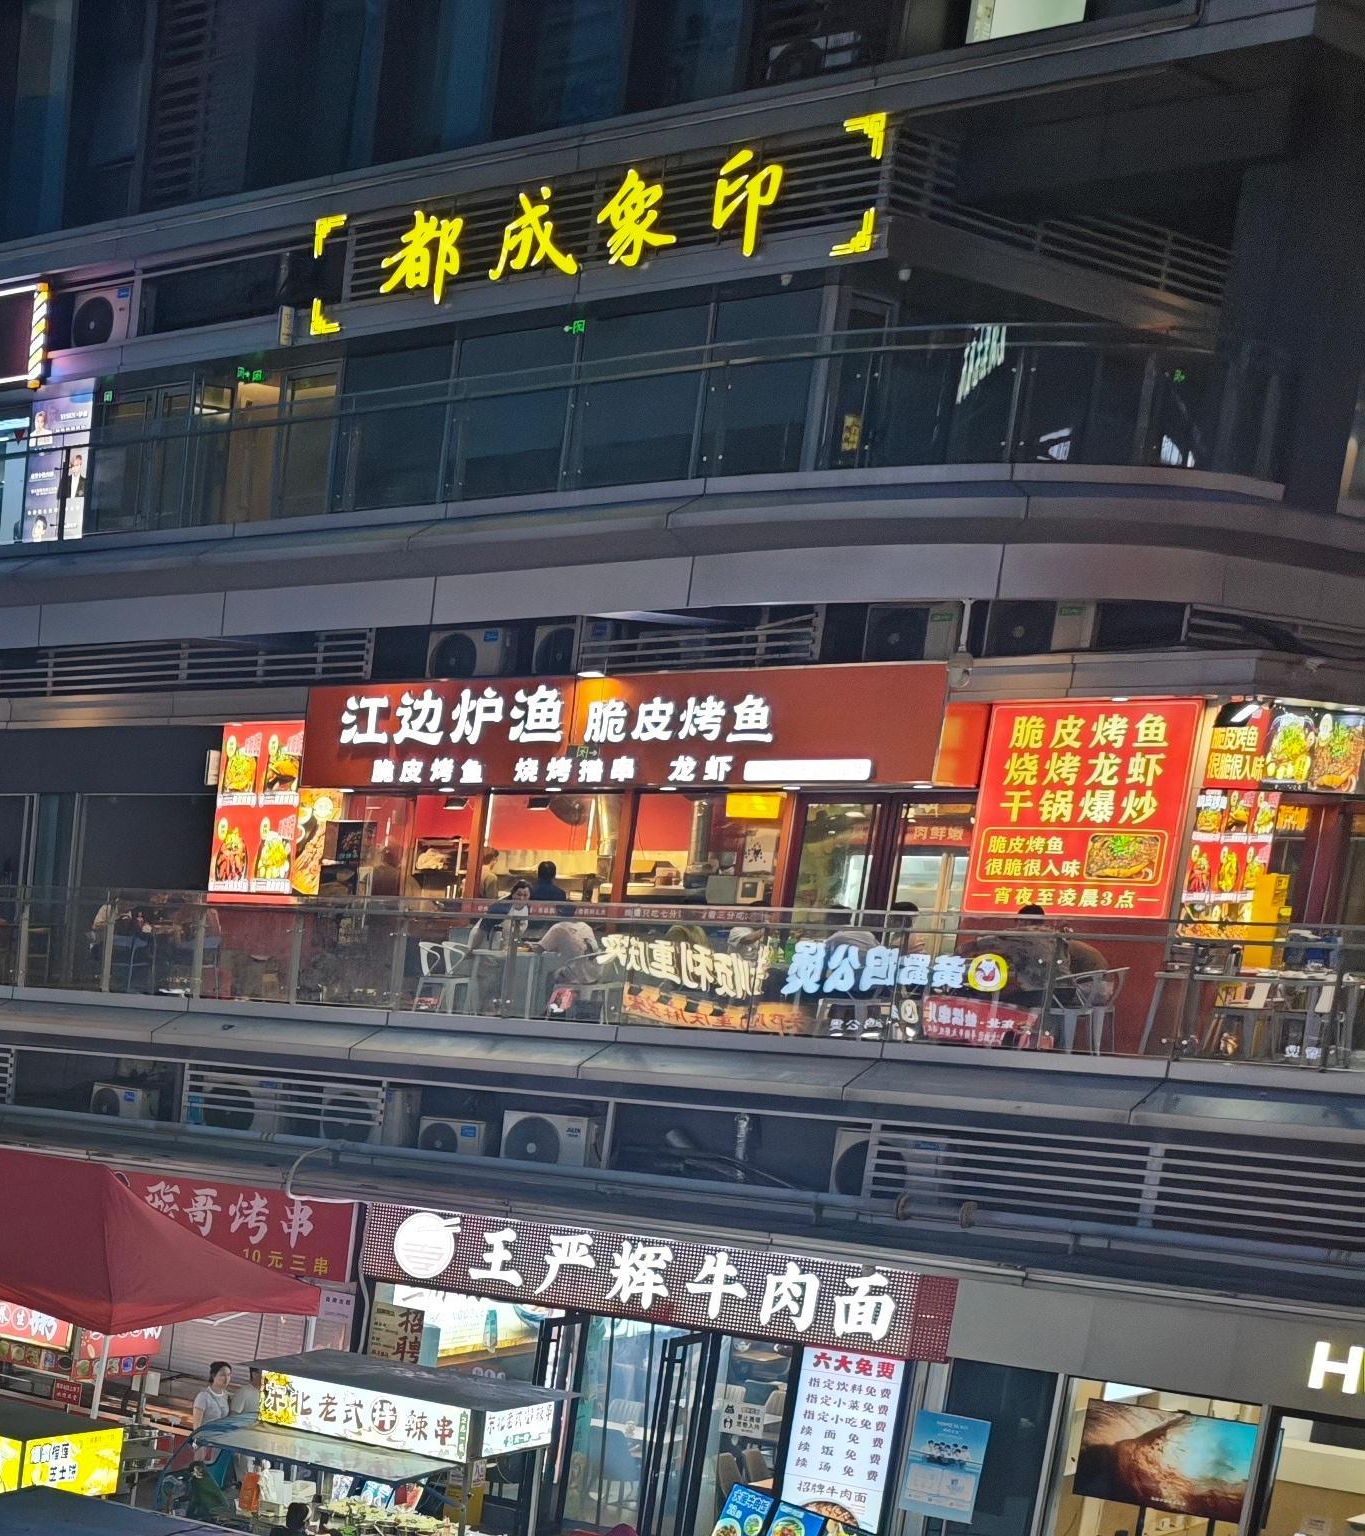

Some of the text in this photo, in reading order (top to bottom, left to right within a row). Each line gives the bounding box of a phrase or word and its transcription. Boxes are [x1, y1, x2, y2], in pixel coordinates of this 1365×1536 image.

[380, 149, 783, 305] 都成象印
[341, 686, 773, 745] 江边炉渔 脆皮烤鱼
[1009, 713, 1170, 749] 脆皮烤鱼
[371, 757, 484, 784] 脆皮烤鱼
[669, 755, 732, 783] 龙虾
[1004, 751, 1165, 787] 烧烤龙虾
[1000, 789, 1158, 825] 干锅爆炒
[988, 833, 1064, 855] 脆皮烤鱼
[985, 858, 1081, 878] 很脆很入味
[993, 887, 1136, 909] 宵夜至凌晨3点
[242, 1247, 329, 1276] 10元三串
[469, 1228, 896, 1341] 王严辉牛肉面
[393, 1308, 423, 1364] 招聘
[813, 1351, 895, 1380] 六大免费
[808, 1376, 892, 1400] 指定饮料免费
[805, 1393, 889, 1417] 指定小菜免费
[803, 1409, 887, 1433] 指定小吃免费
[800, 1425, 884, 1449] 续面免费
[795, 1457, 879, 1482] 续汤免费
[796, 1481, 868, 1504] 招牌牛肉面
